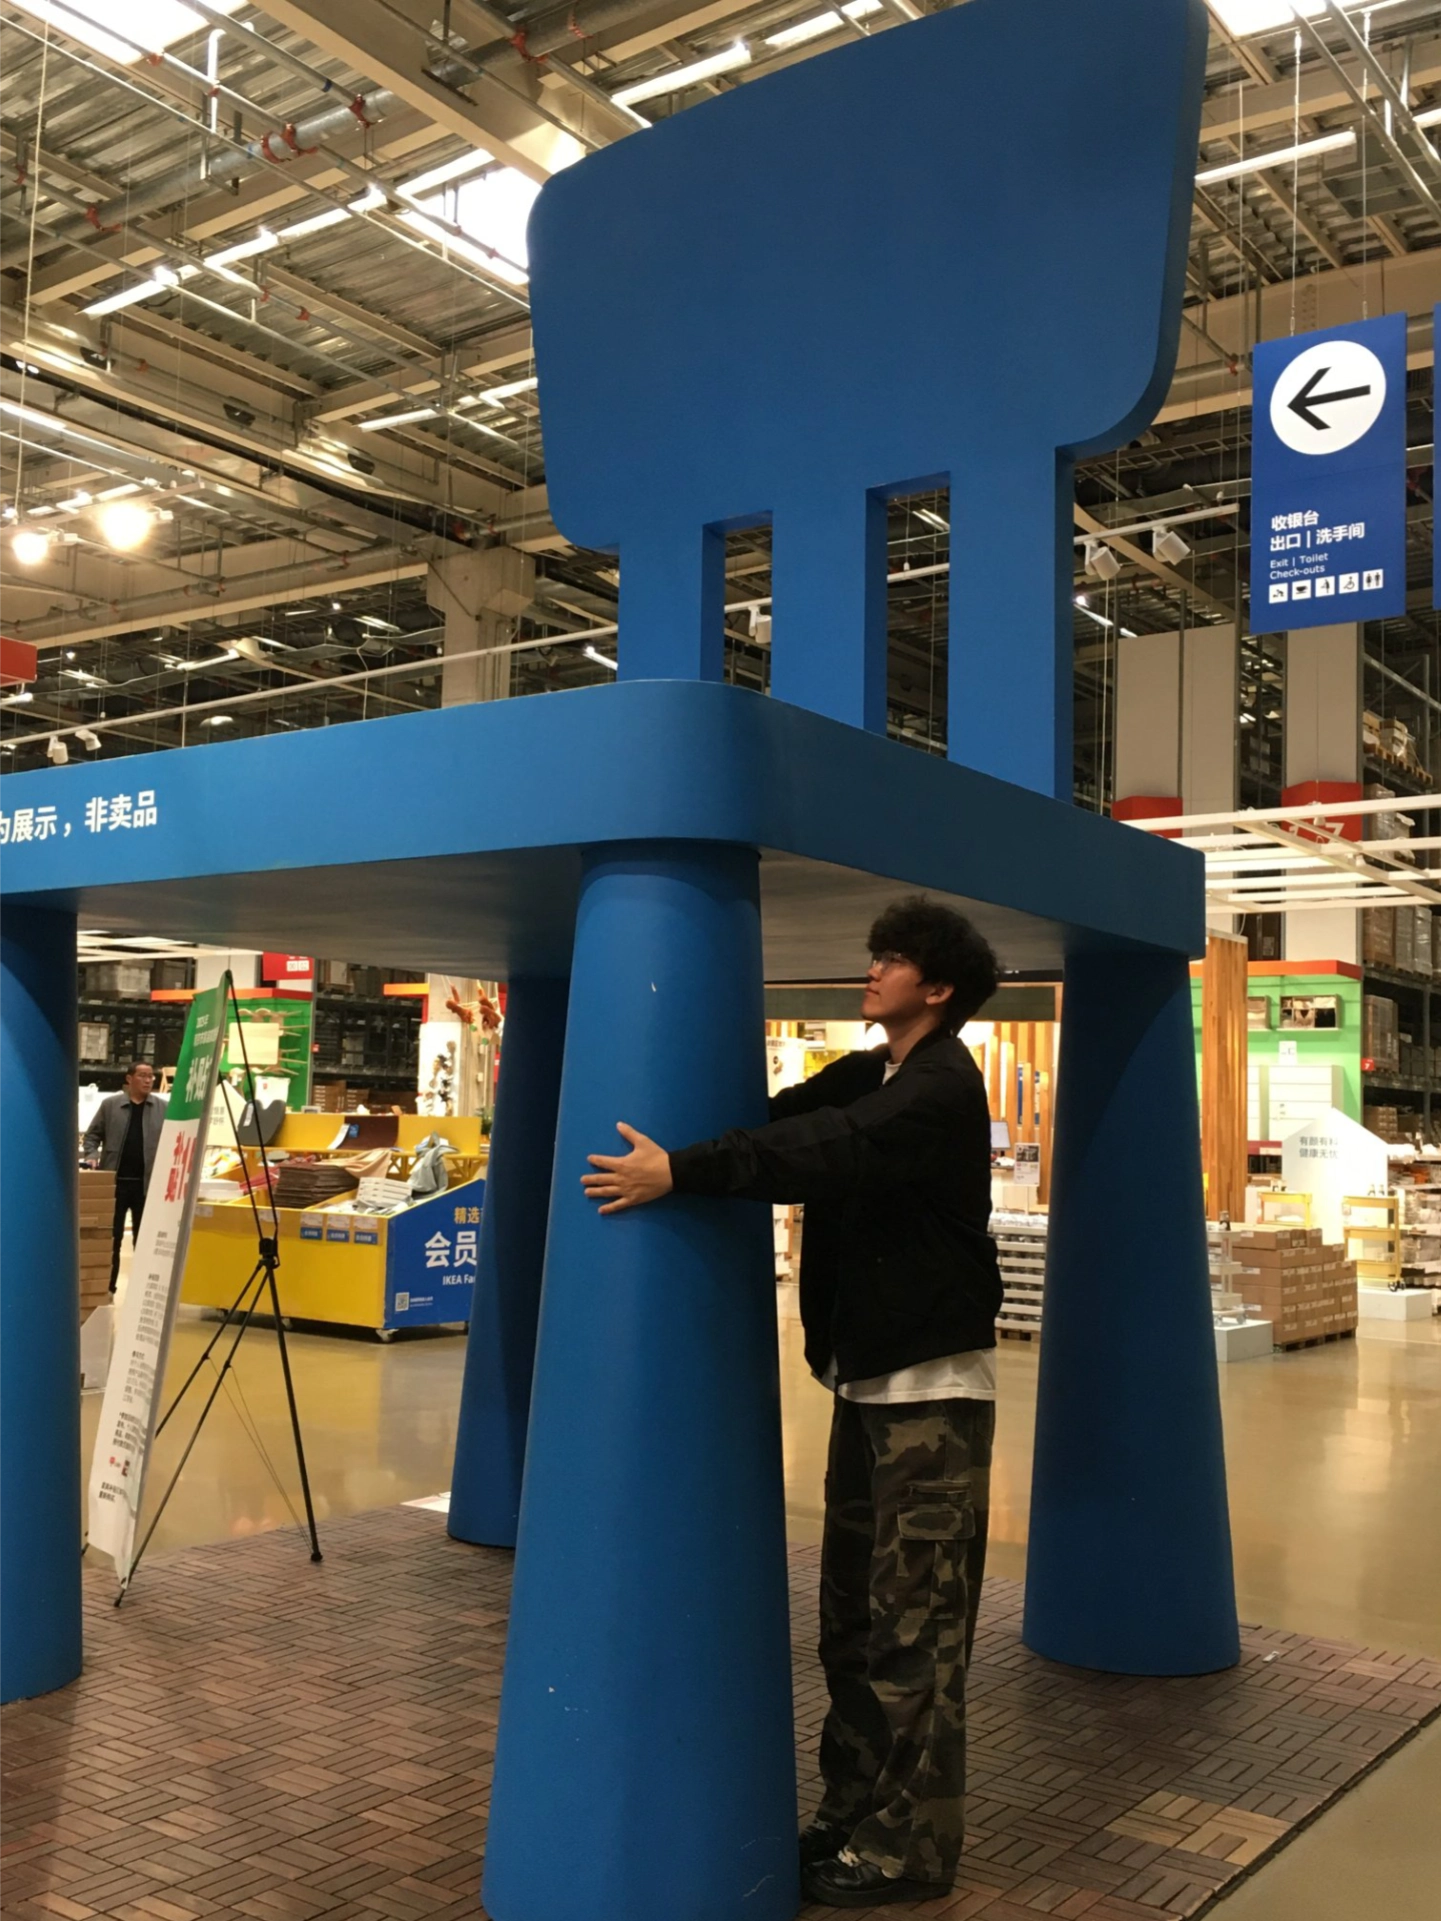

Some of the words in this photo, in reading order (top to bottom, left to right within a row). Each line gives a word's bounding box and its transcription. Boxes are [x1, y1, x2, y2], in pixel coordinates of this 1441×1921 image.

[1271, 510, 1319, 531] 收银台
[1270, 533, 1301, 551] 出口
[1315, 522, 1365, 545] 洗手间
[1270, 558, 1289, 569] Exit
[1299, 552, 1329, 564] Toilet
[1269, 564, 1325, 580] Check-outs
[454, 1206, 483, 1225] 精选
[425, 1231, 478, 1268] 会员
[443, 1275, 462, 1286] IKEA
[463, 1273, 476, 1285] Fa
